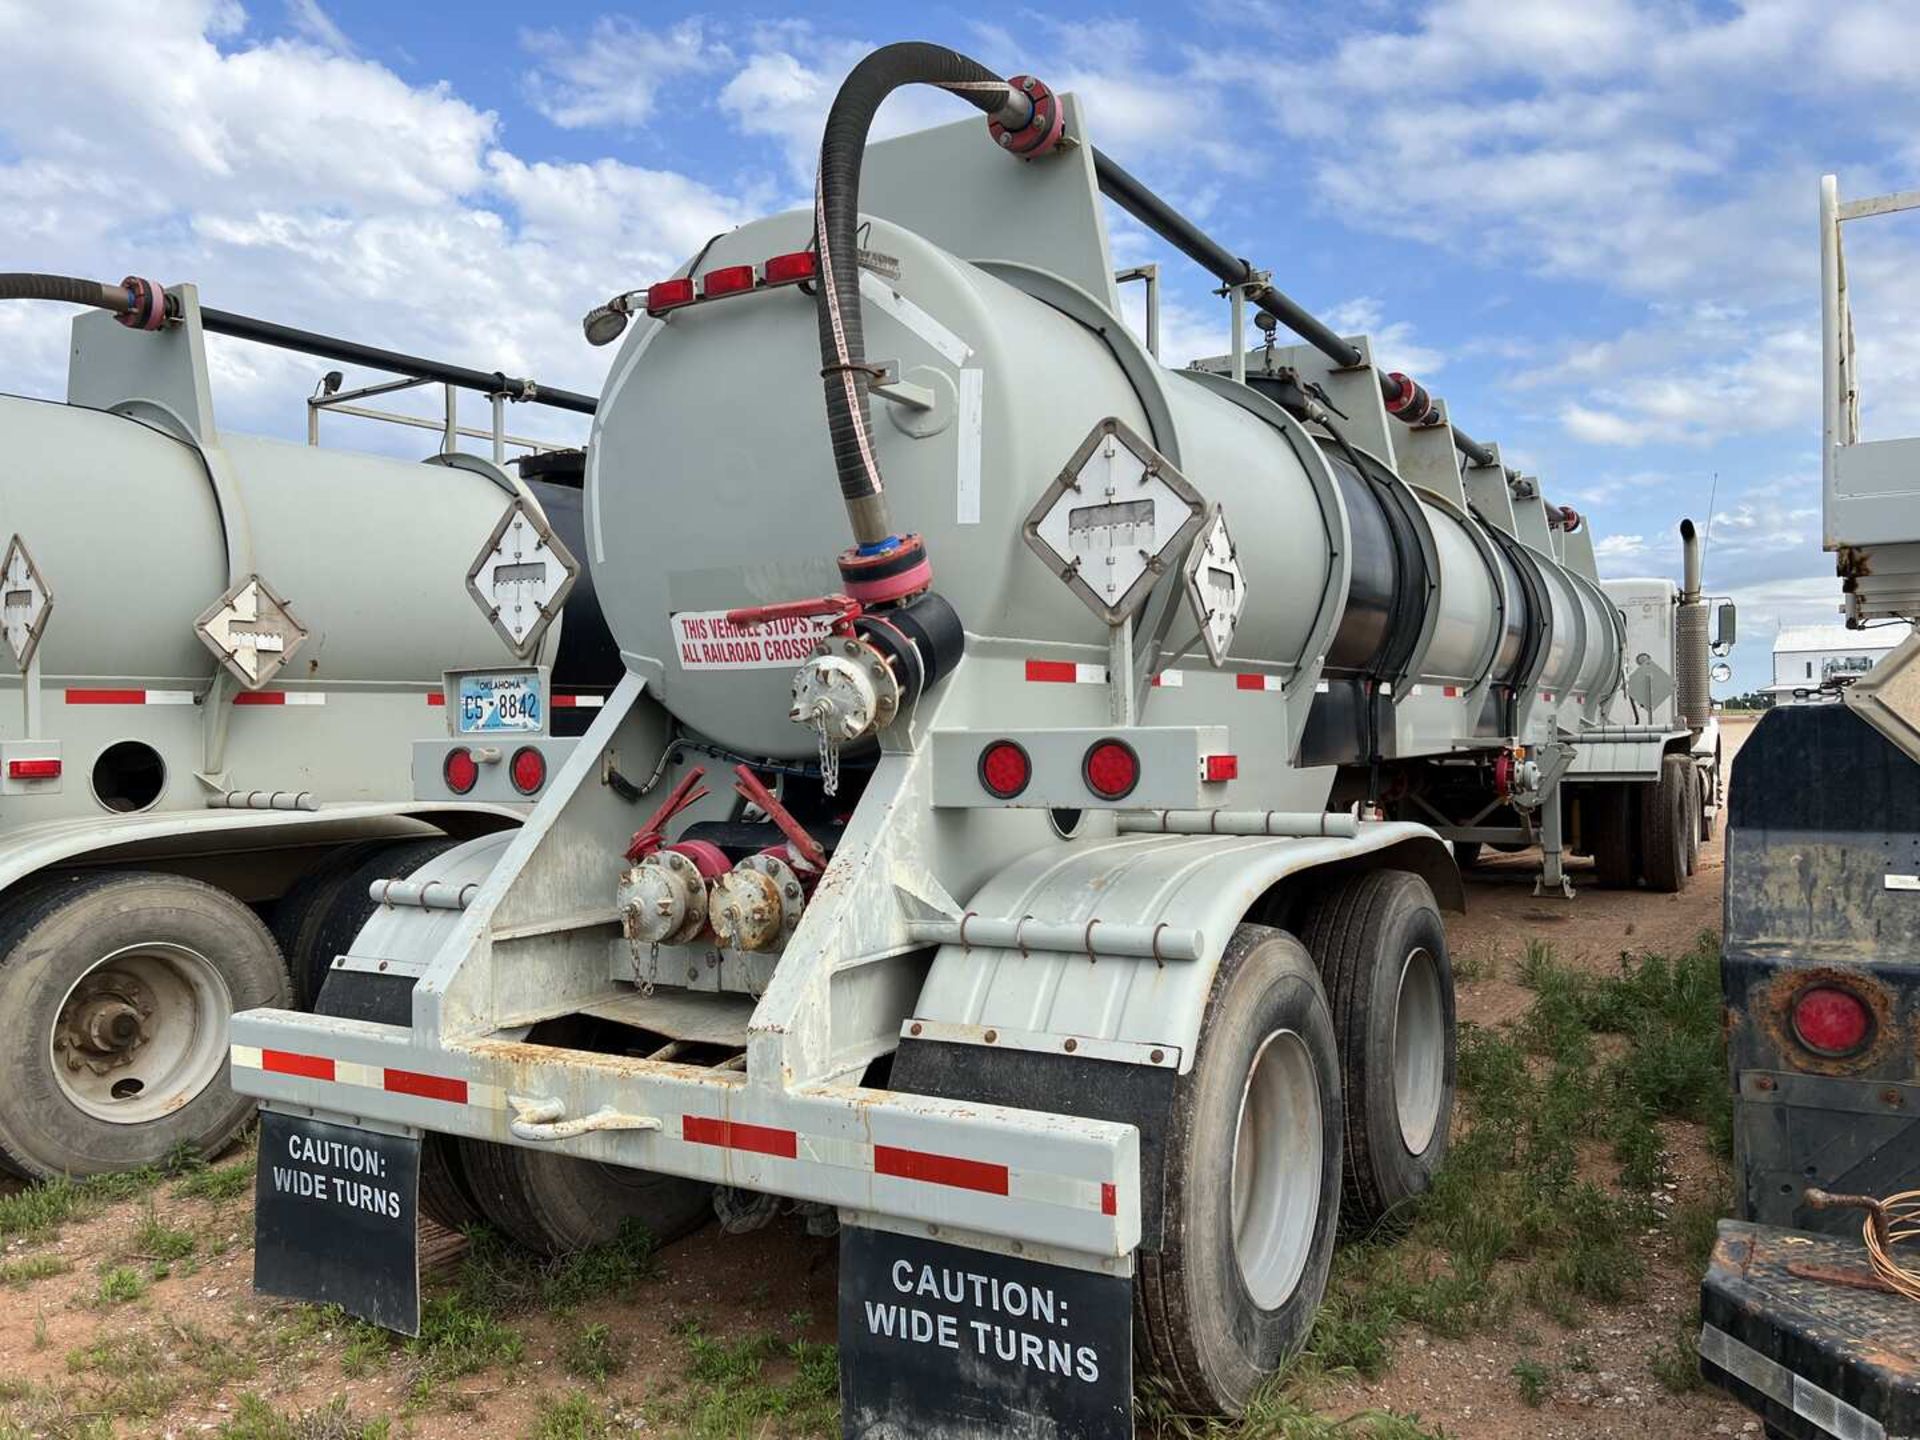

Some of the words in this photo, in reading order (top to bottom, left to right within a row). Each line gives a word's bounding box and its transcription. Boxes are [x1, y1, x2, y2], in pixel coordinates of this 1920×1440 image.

[681, 618, 708, 640] THIS
[765, 616, 808, 637] STOPS
[682, 643, 702, 664] ALL
[703, 641, 762, 663] RAILROAD
[480, 681, 521, 690] OKLAHOMA
[288, 1134, 386, 1178] CAUTION:
[273, 1166, 328, 1200] WIDE
[332, 1177, 401, 1219] TURNS
[891, 1259, 1069, 1327] CAUTION:
[864, 1301, 960, 1349] WIDE
[969, 1321, 1099, 1383] TURNS
